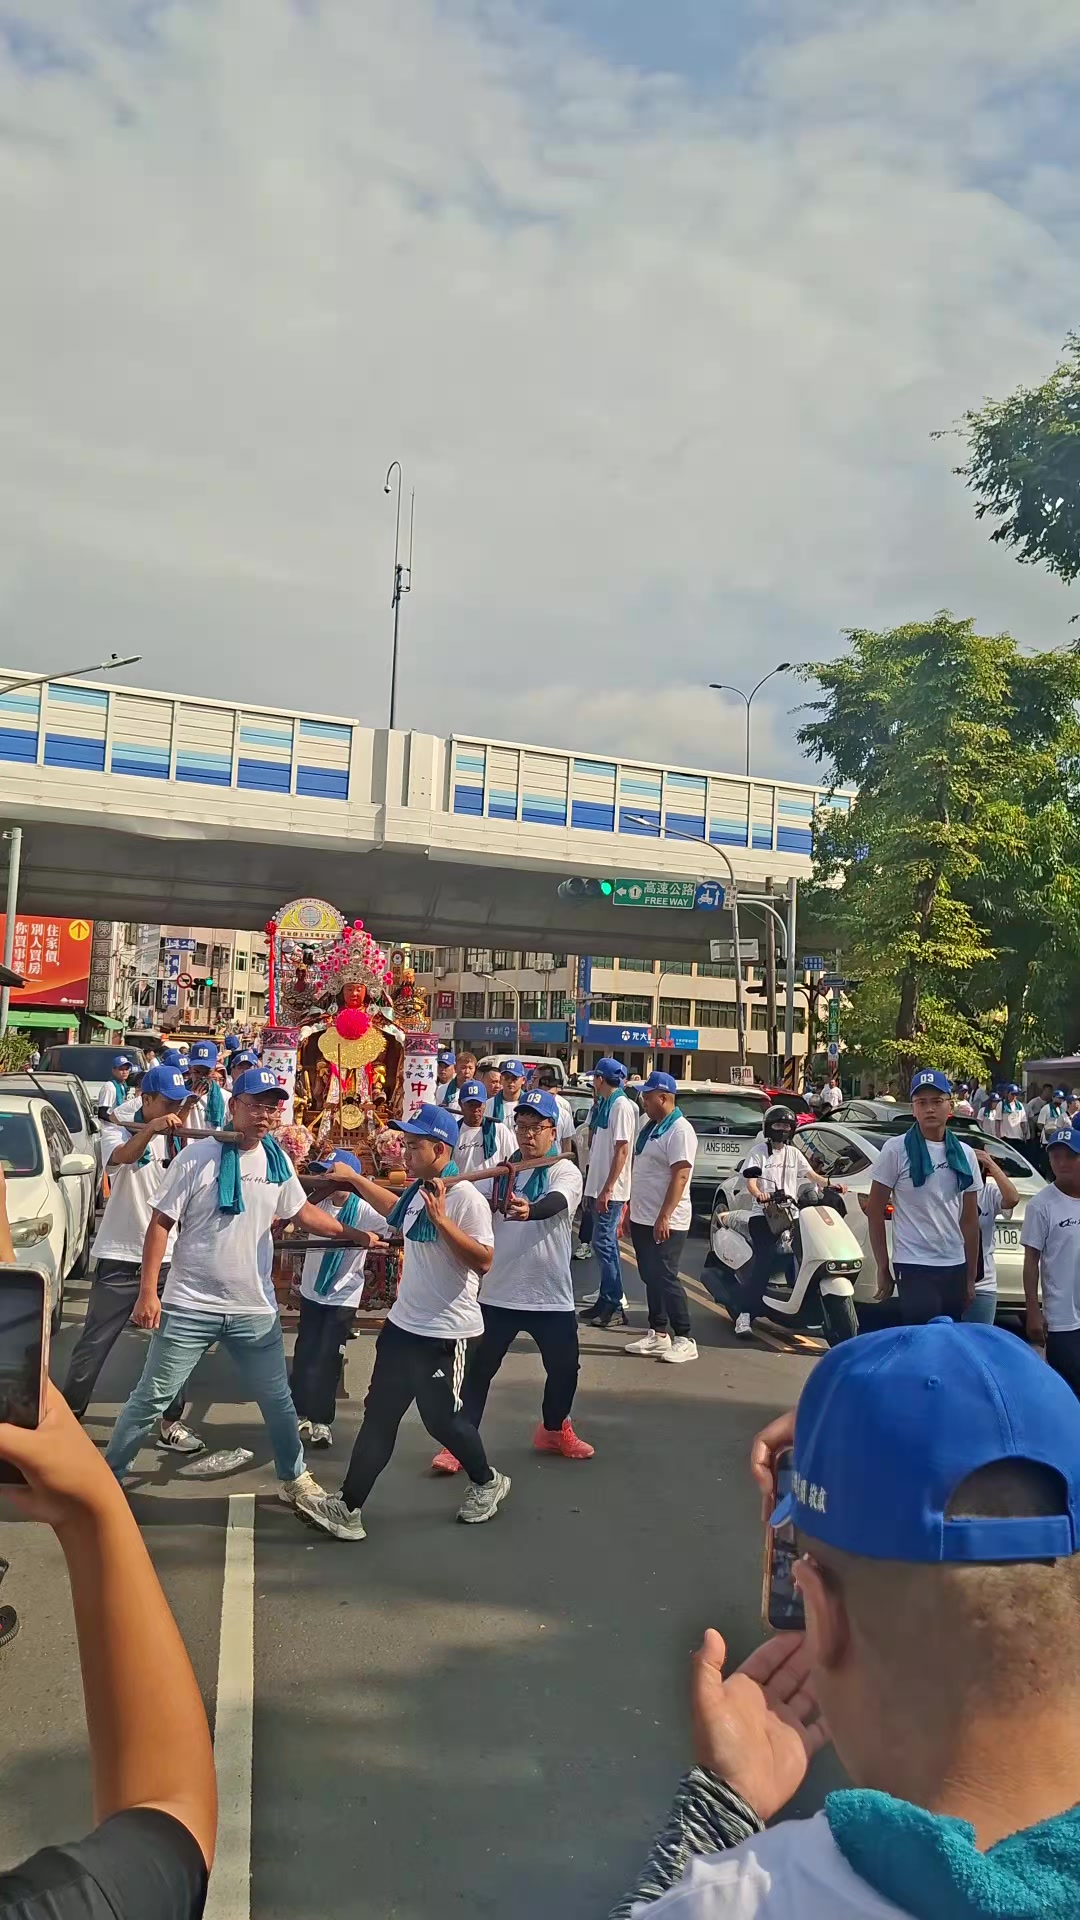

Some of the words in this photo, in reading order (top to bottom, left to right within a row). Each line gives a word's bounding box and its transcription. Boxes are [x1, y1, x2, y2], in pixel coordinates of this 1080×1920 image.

[643, 881, 695, 896] 高速公路
[13, 921, 28, 974] 你買事業
[28, 923, 44, 975] 別人買房
[198, 1048, 209, 1058] 03
[506, 1061, 516, 1069] 03
[260, 1071, 276, 1086] 03
[731, 1067, 752, 1079] 捐血
[920, 1073, 935, 1085] 03
[468, 1086, 479, 1095] 03
[526, 1092, 542, 1104] 03
[1057, 1130, 1072, 1140] 03
